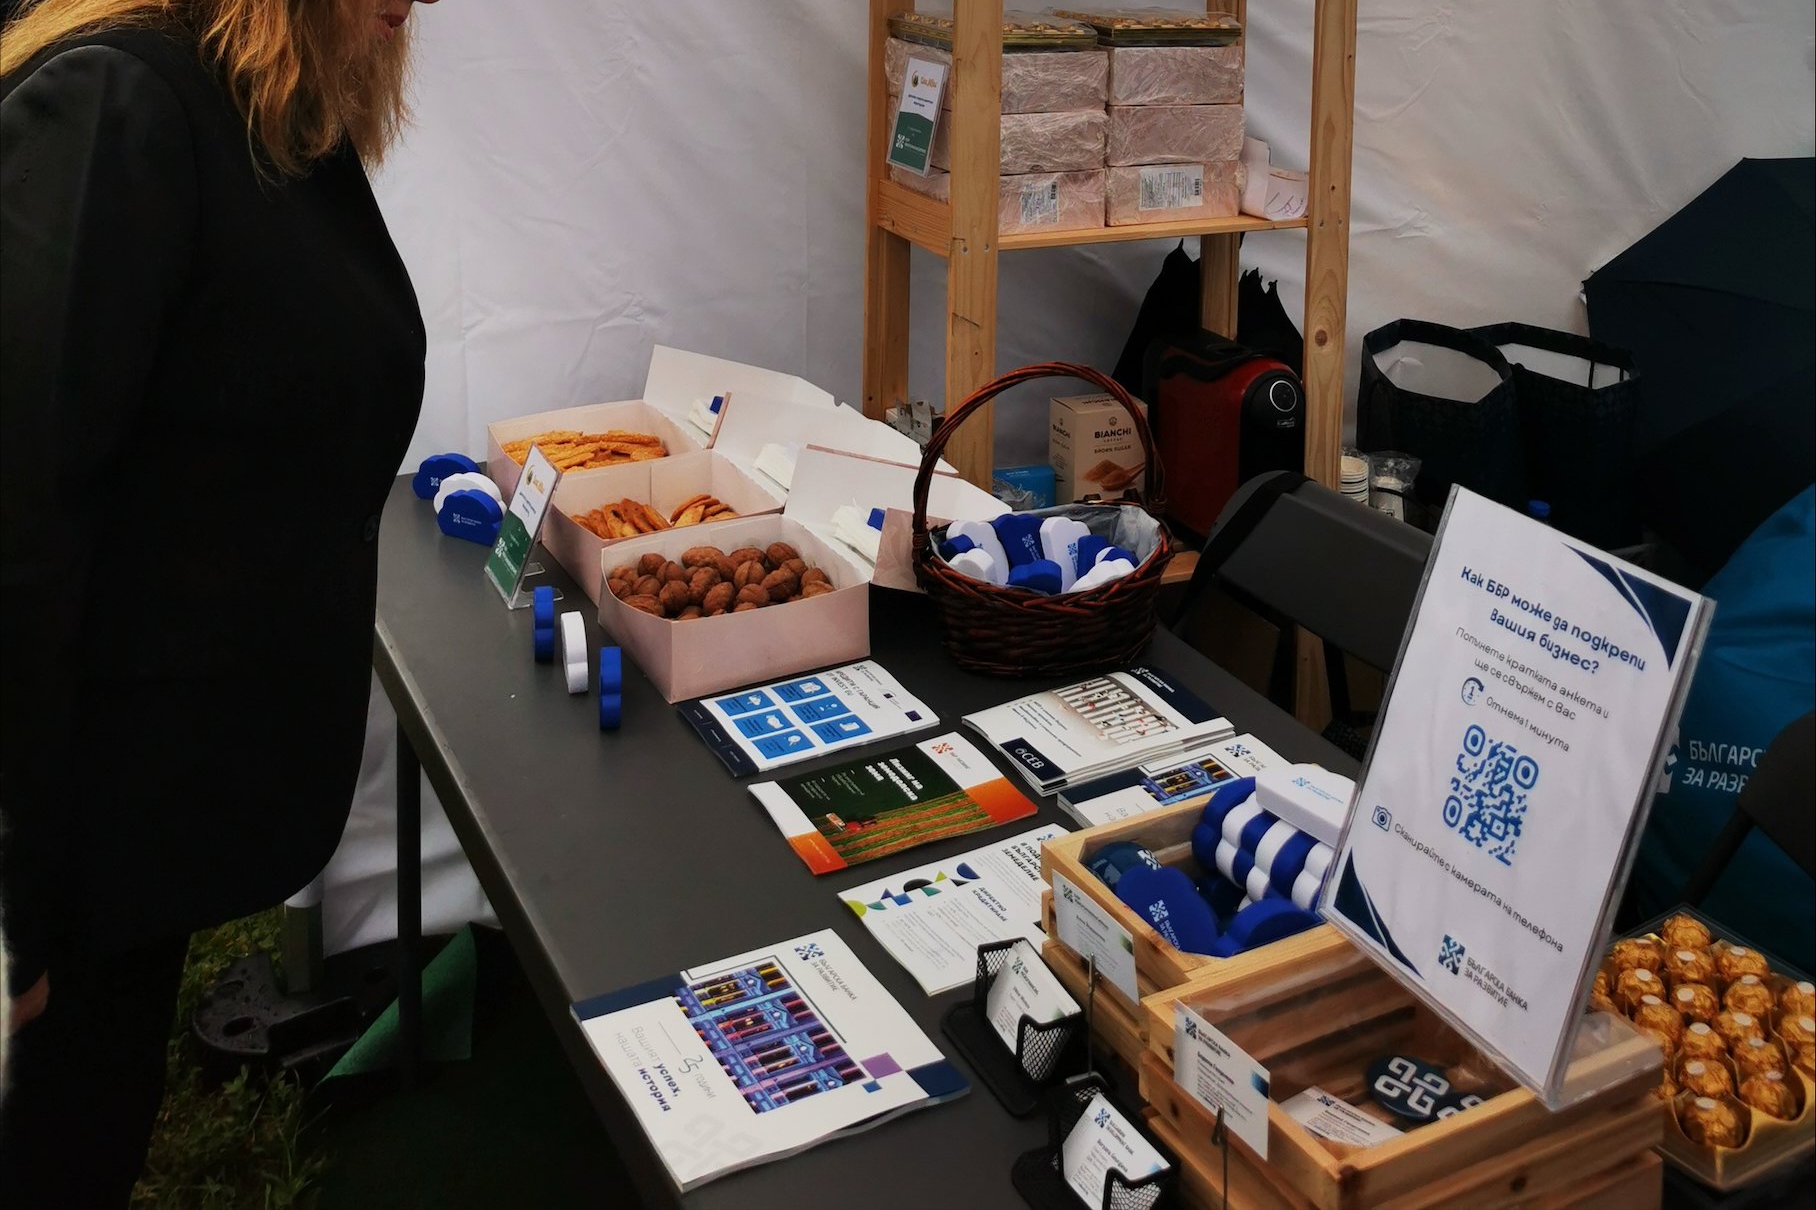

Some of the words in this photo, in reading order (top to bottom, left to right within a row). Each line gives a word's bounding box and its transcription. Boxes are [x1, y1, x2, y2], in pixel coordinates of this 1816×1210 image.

[1094, 427, 1131, 439] BIANCHI
[1461, 566, 1484, 588] Как
[1486, 579, 1510, 599] ББР
[1511, 595, 1552, 622] може
[1554, 616, 1569, 632] да
[1571, 626, 1646, 671] подкрепи
[1490, 608, 1536, 642] Вашия
[1540, 634, 1600, 674] бизнес?
[1474, 658, 1489, 671] ще
[1490, 667, 1502, 679] се
[1502, 674, 1545, 704] свържем
[1506, 655, 1557, 691] кратката
[1559, 683, 1602, 714] анкета
[1486, 696, 1524, 725] Отнема
[1529, 724, 1570, 752] минута
[889, 758, 915, 780] Лизинг
[911, 780, 923, 790] на
[1689, 740, 1766, 767] БЪЛГАРС
[1682, 767, 1705, 787] ЗА
[1011, 845, 1041, 873] БЪЛГАРС
[1026, 846, 1041, 861] ПОД
[1394, 824, 1444, 868] Сканирайте
[1450, 865, 1502, 906] камерата
[1502, 902, 1513, 915] на
[1513, 911, 1564, 953] телефона
[1464, 969, 1474, 981] ЗА
[1473, 974, 1509, 1008] РАЗВИТИЕ
[1467, 956, 1505, 991] БЪЛГАРСКА
[1506, 985, 1528, 1011] БАНКА
[615, 1032, 641, 1067] нашата
[638, 1068, 672, 1111] история
[632, 1026, 661, 1062] Вашият
[653, 1063, 681, 1097] успех,
[678, 1055, 703, 1073] 25
